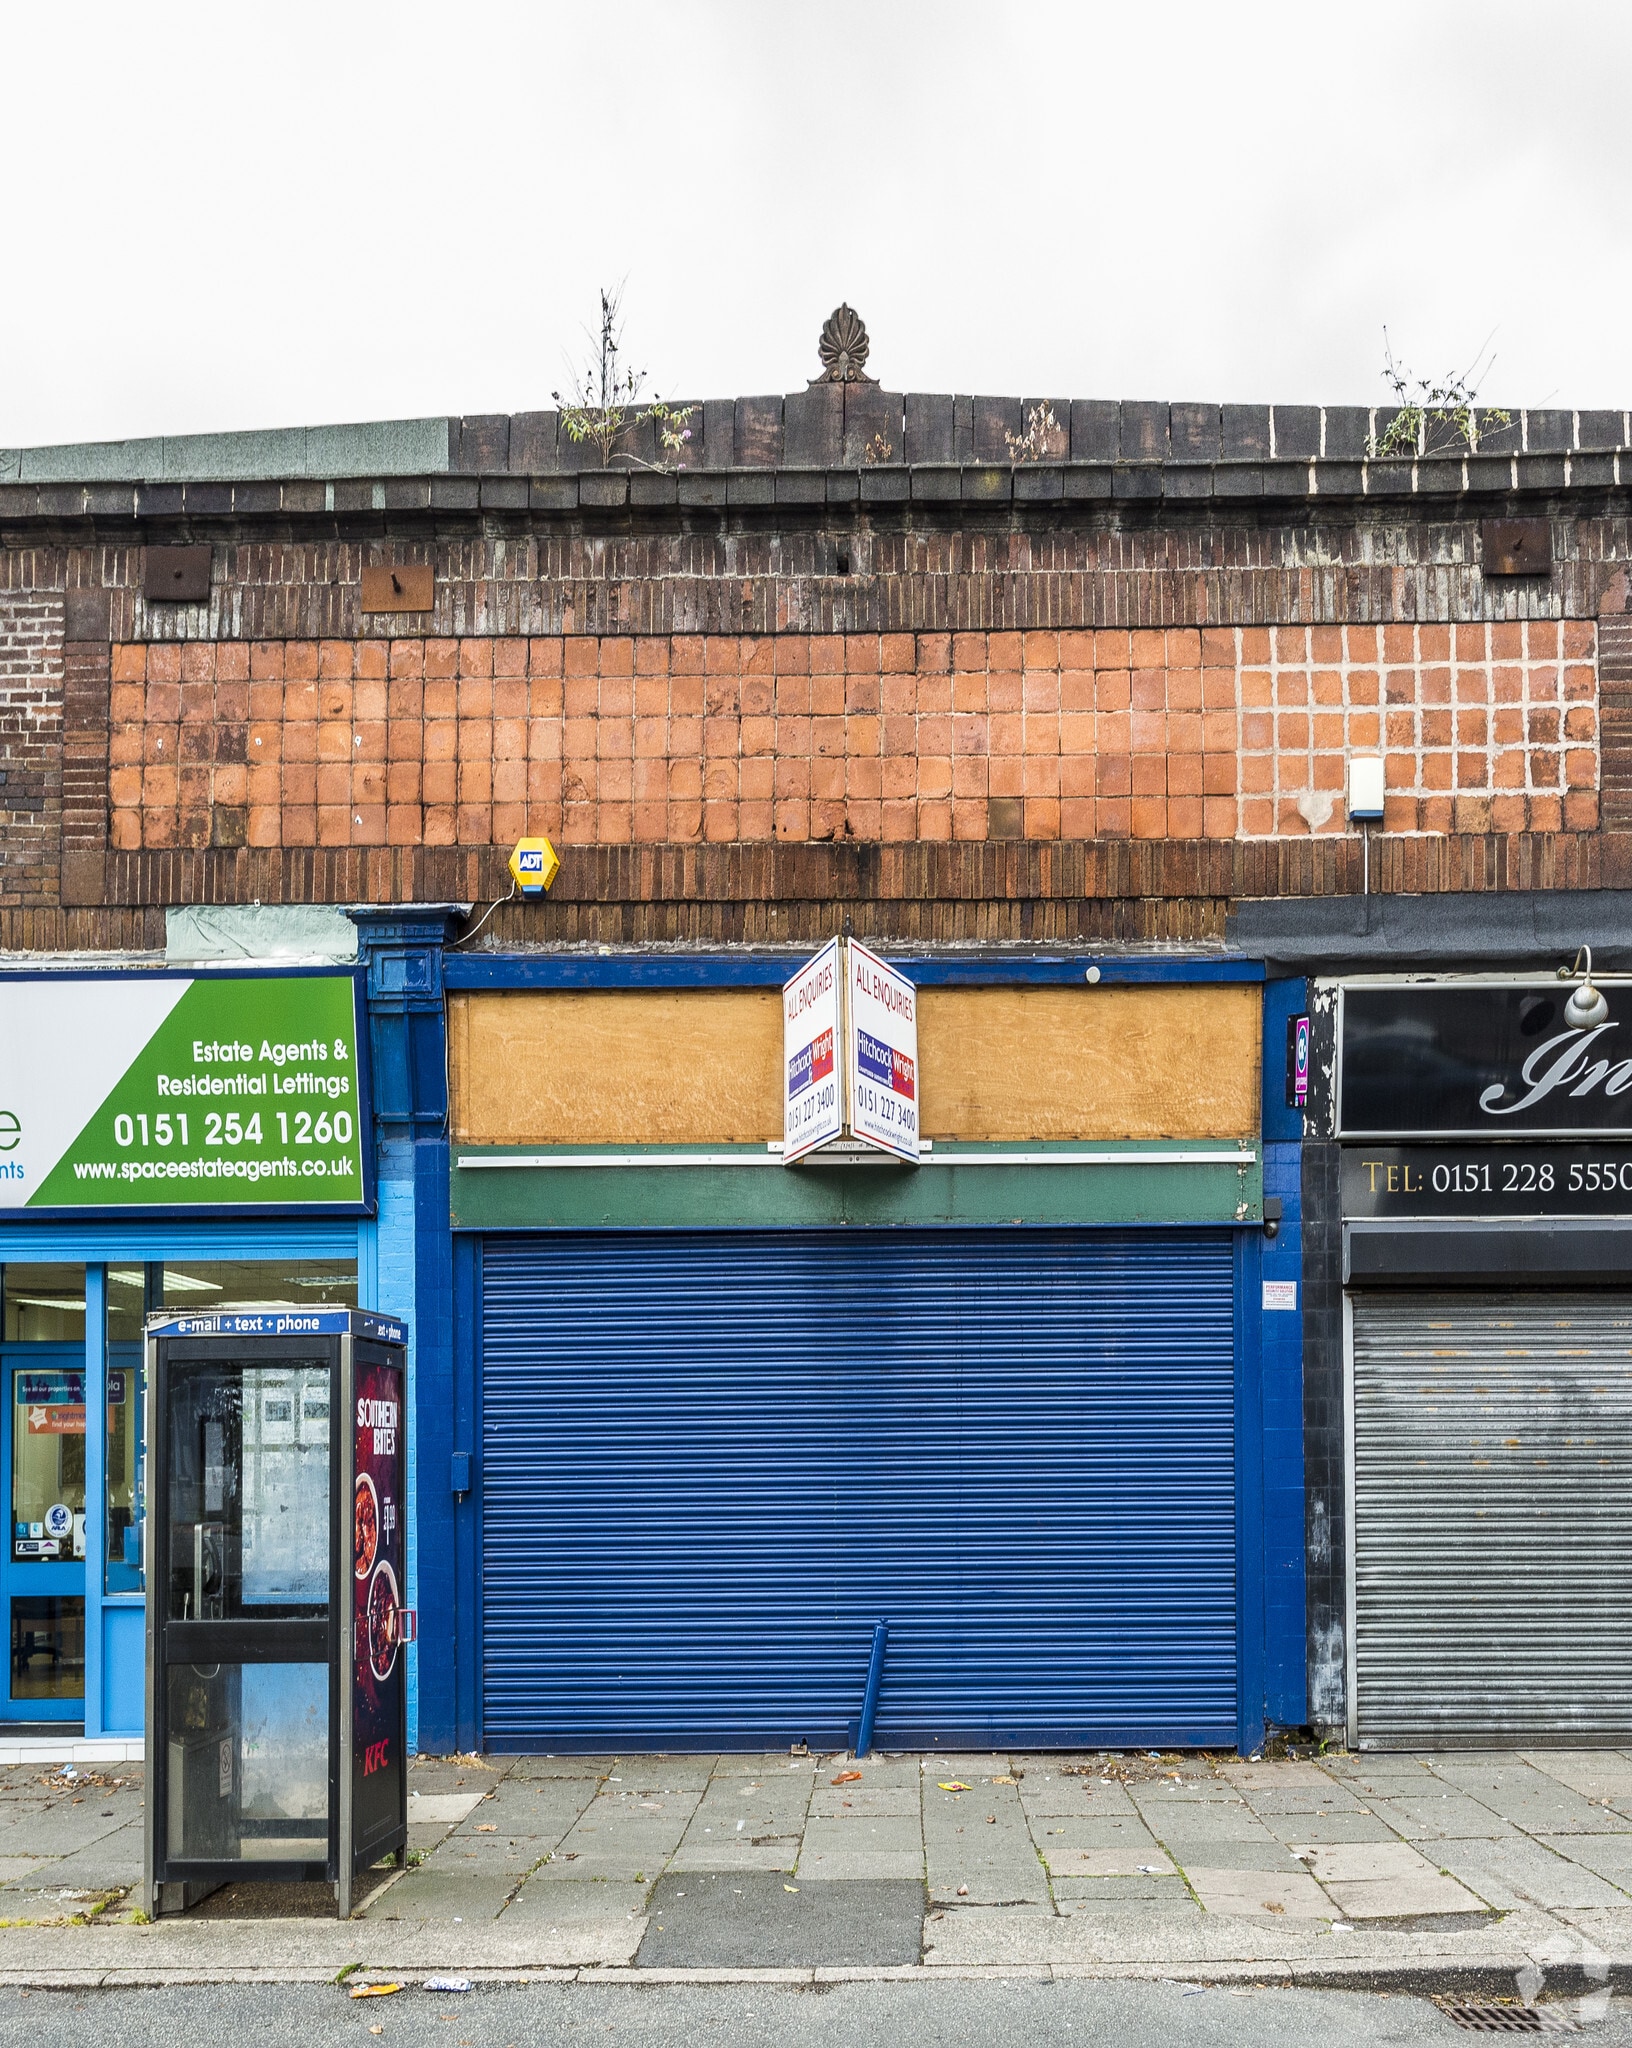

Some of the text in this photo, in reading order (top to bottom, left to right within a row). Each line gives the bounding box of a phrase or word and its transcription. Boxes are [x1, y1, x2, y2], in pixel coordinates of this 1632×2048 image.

[520, 854, 542, 869] ADT
[788, 963, 832, 1023] ALL ENQUIRIES
[856, 964, 912, 1022] ALL ENQUIRIES
[193, 1038, 349, 1066] Estate Agents &
[812, 1031, 832, 1062] Wright
[858, 1030, 892, 1068] Hitchcock
[893, 1050, 914, 1082] Wright
[157, 1072, 349, 1099] Residential Lettings
[788, 1101, 801, 1131] 0151
[803, 1095, 815, 1123] 227
[816, 1083, 834, 1114] 3400
[858, 1084, 915, 1132] 0151 227 3400
[114, 1110, 353, 1147] 0151 254 1260
[73, 1155, 354, 1183] www.spaceestateagents.co.uk
[1432, 1164, 1493, 1193] 0151
[1502, 1163, 1556, 1192] 228
[1568, 1163, 1632, 1192] 5550
[178, 1316, 221, 1332] e-mail
[235, 1317, 263, 1331] text
[277, 1314, 320, 1334] phone
[388, 1323, 401, 1341] phone
[357, 1397, 398, 1428] SOUTHERN
[373, 1428, 395, 1455] BITES
[364, 1737, 390, 1777] KFC
